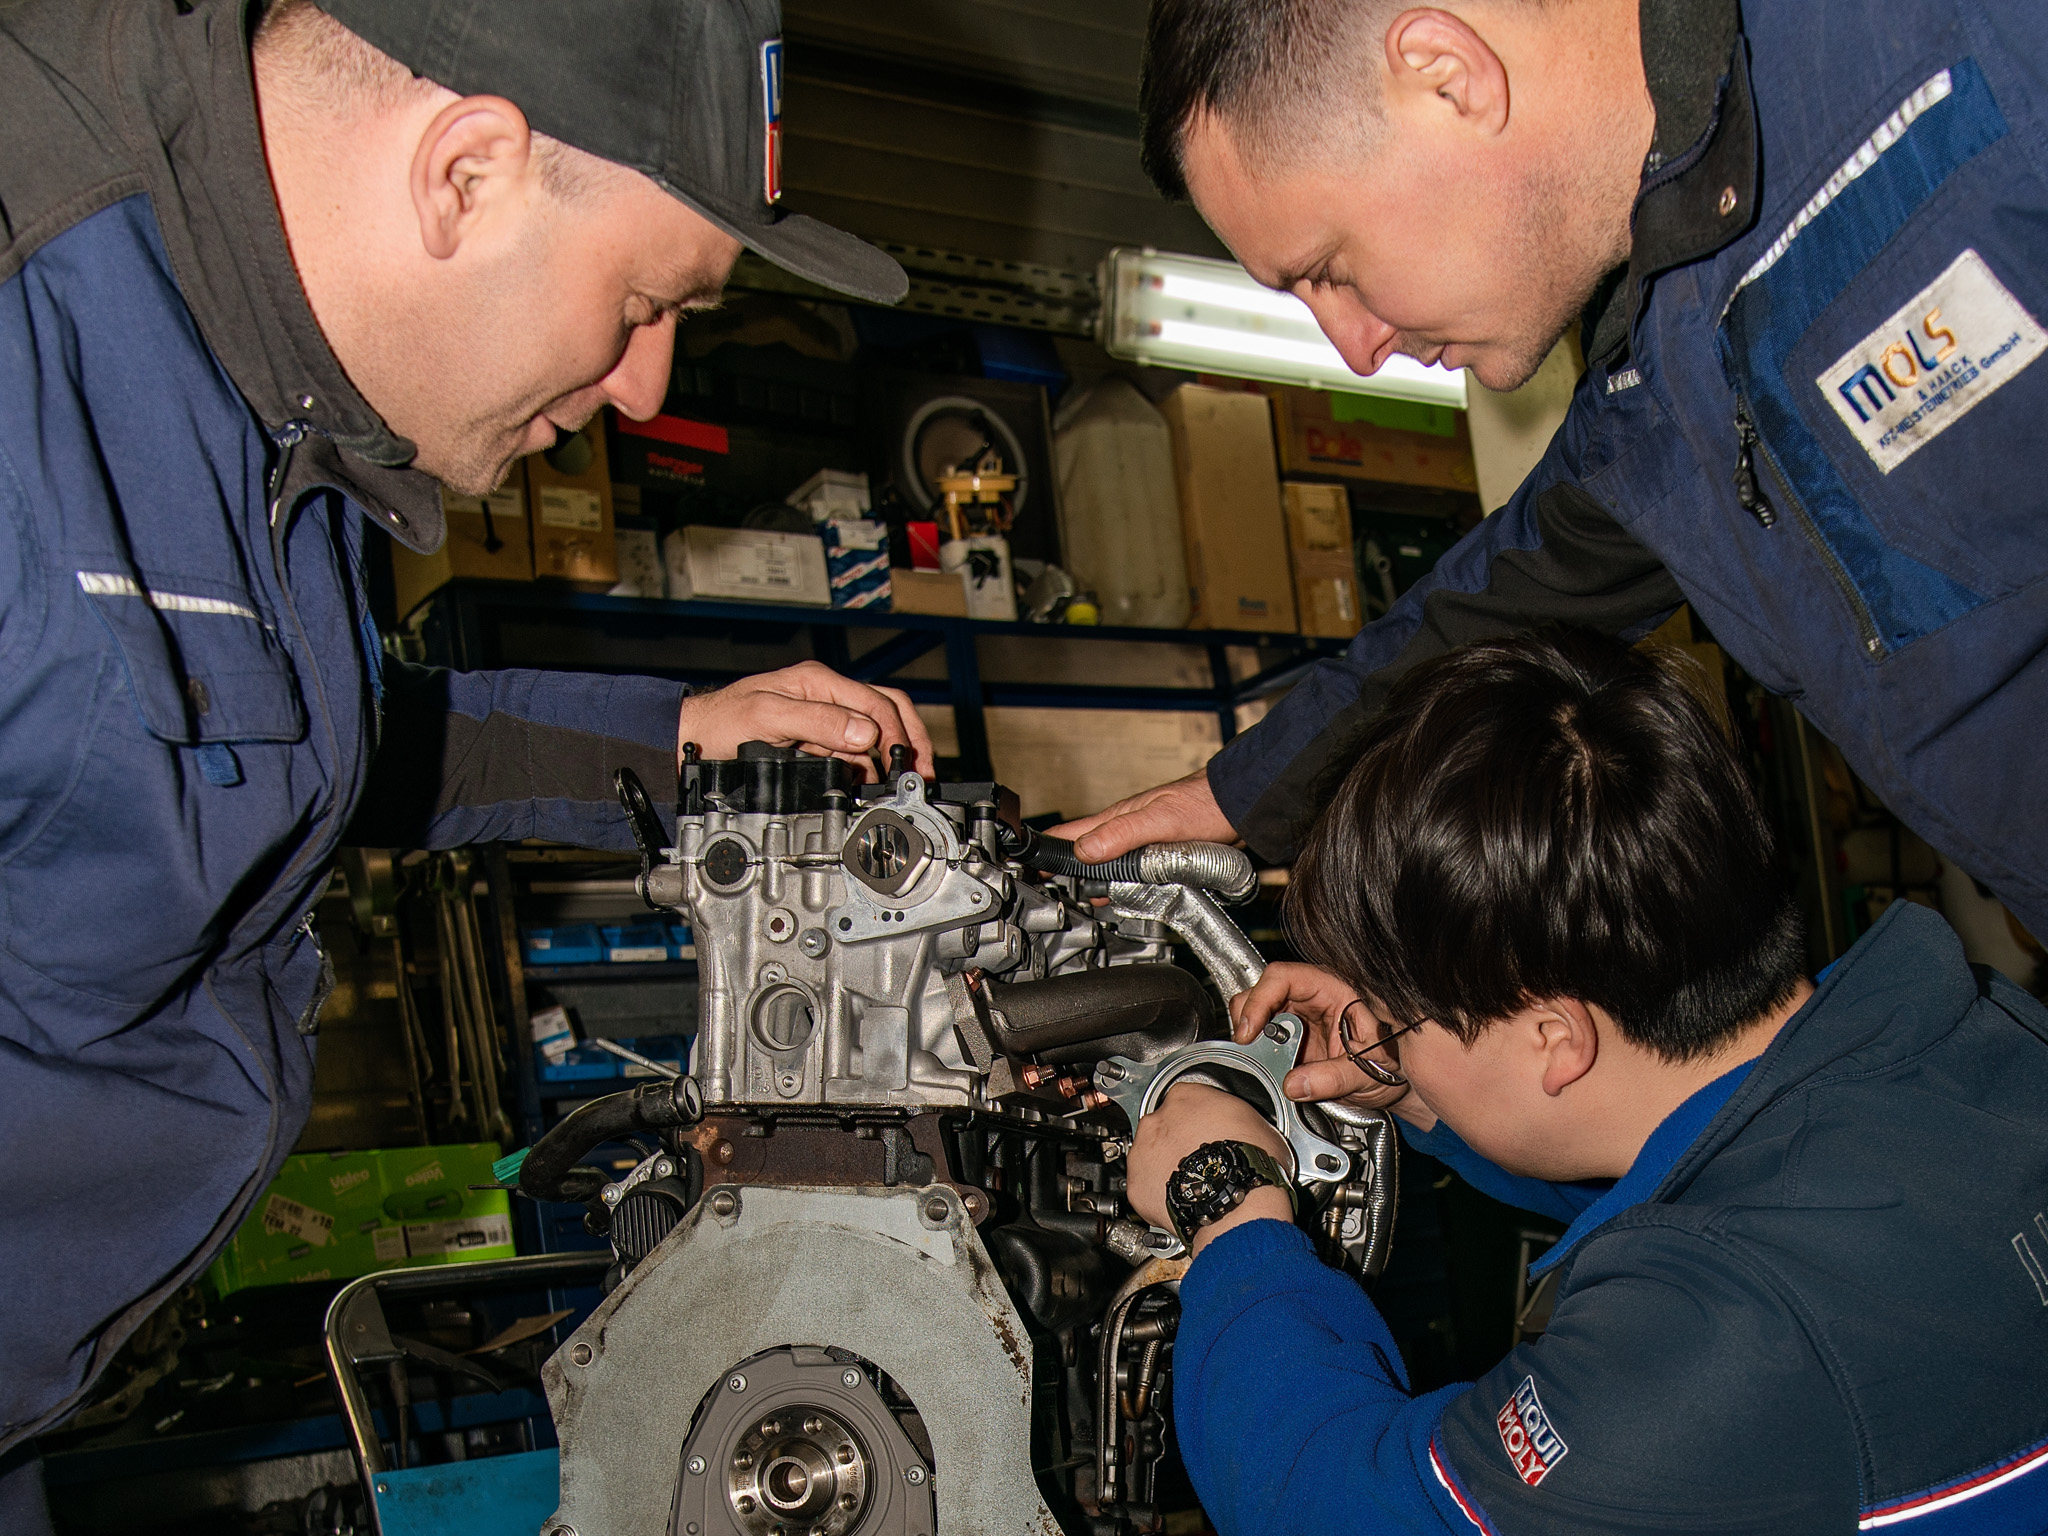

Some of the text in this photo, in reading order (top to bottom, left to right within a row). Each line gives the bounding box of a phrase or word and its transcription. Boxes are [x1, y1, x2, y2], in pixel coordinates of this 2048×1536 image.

[1979, 331, 2022, 370] GmbH
[1917, 356, 1973, 402] & HAACK
[1307, 428, 1362, 458] Dole
[329, 1168, 370, 1190] Valeo
[1499, 1403, 1546, 1479] MOLY
[1515, 1382, 1562, 1464] LIQUI
